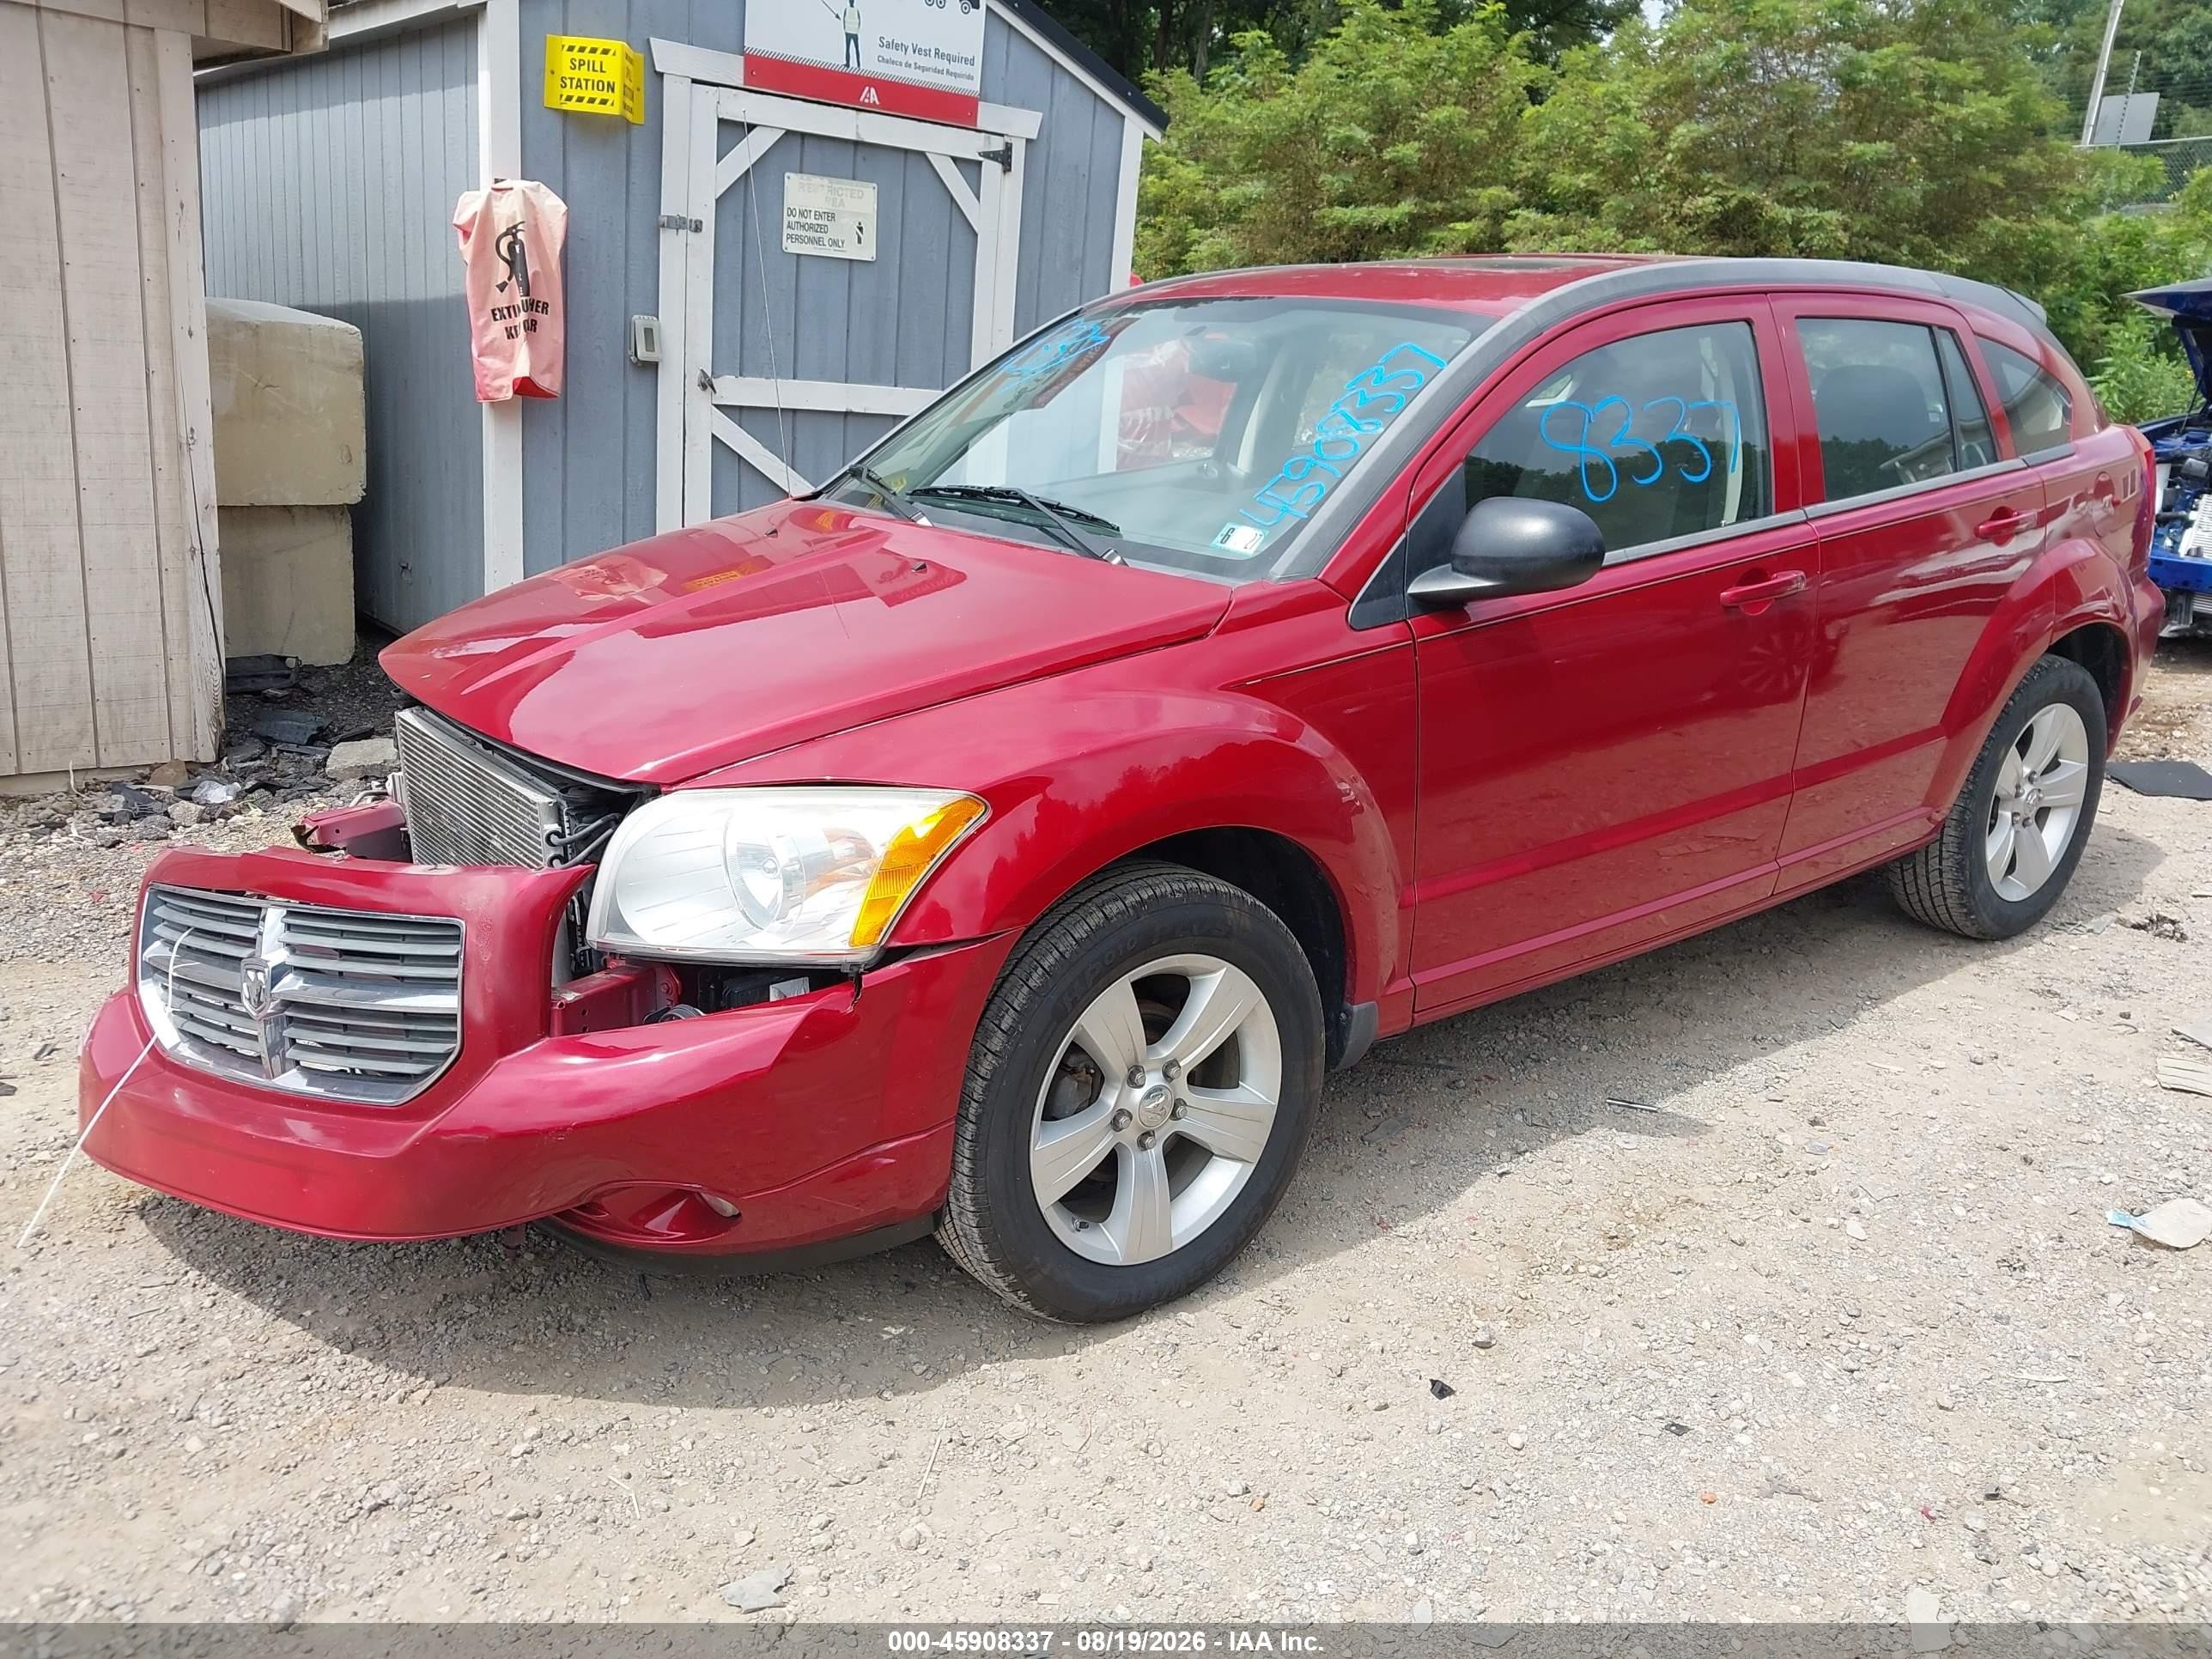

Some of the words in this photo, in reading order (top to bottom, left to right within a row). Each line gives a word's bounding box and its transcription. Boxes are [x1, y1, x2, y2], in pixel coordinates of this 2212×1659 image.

[878, 36, 909, 55] Safety
[911, 43, 932, 58] Vest
[934, 48, 975, 66] Required
[569, 58, 606, 73] SPILL
[877, 55, 903, 67] Chaleco
[904, 59, 912, 69] de
[914, 62, 945, 75] Seguridad
[560, 76, 616, 94] STATION
[787, 207, 797, 217] DO
[799, 209, 812, 219] NOT
[814, 210, 836, 222] ENTER
[787, 221, 829, 234] AUTHORIZED
[787, 233, 826, 246] PERSONNEL
[828, 237, 846, 248] ONLY
[1239, 342, 1448, 526] 45908337
[1539, 394, 1743, 502] 8337
